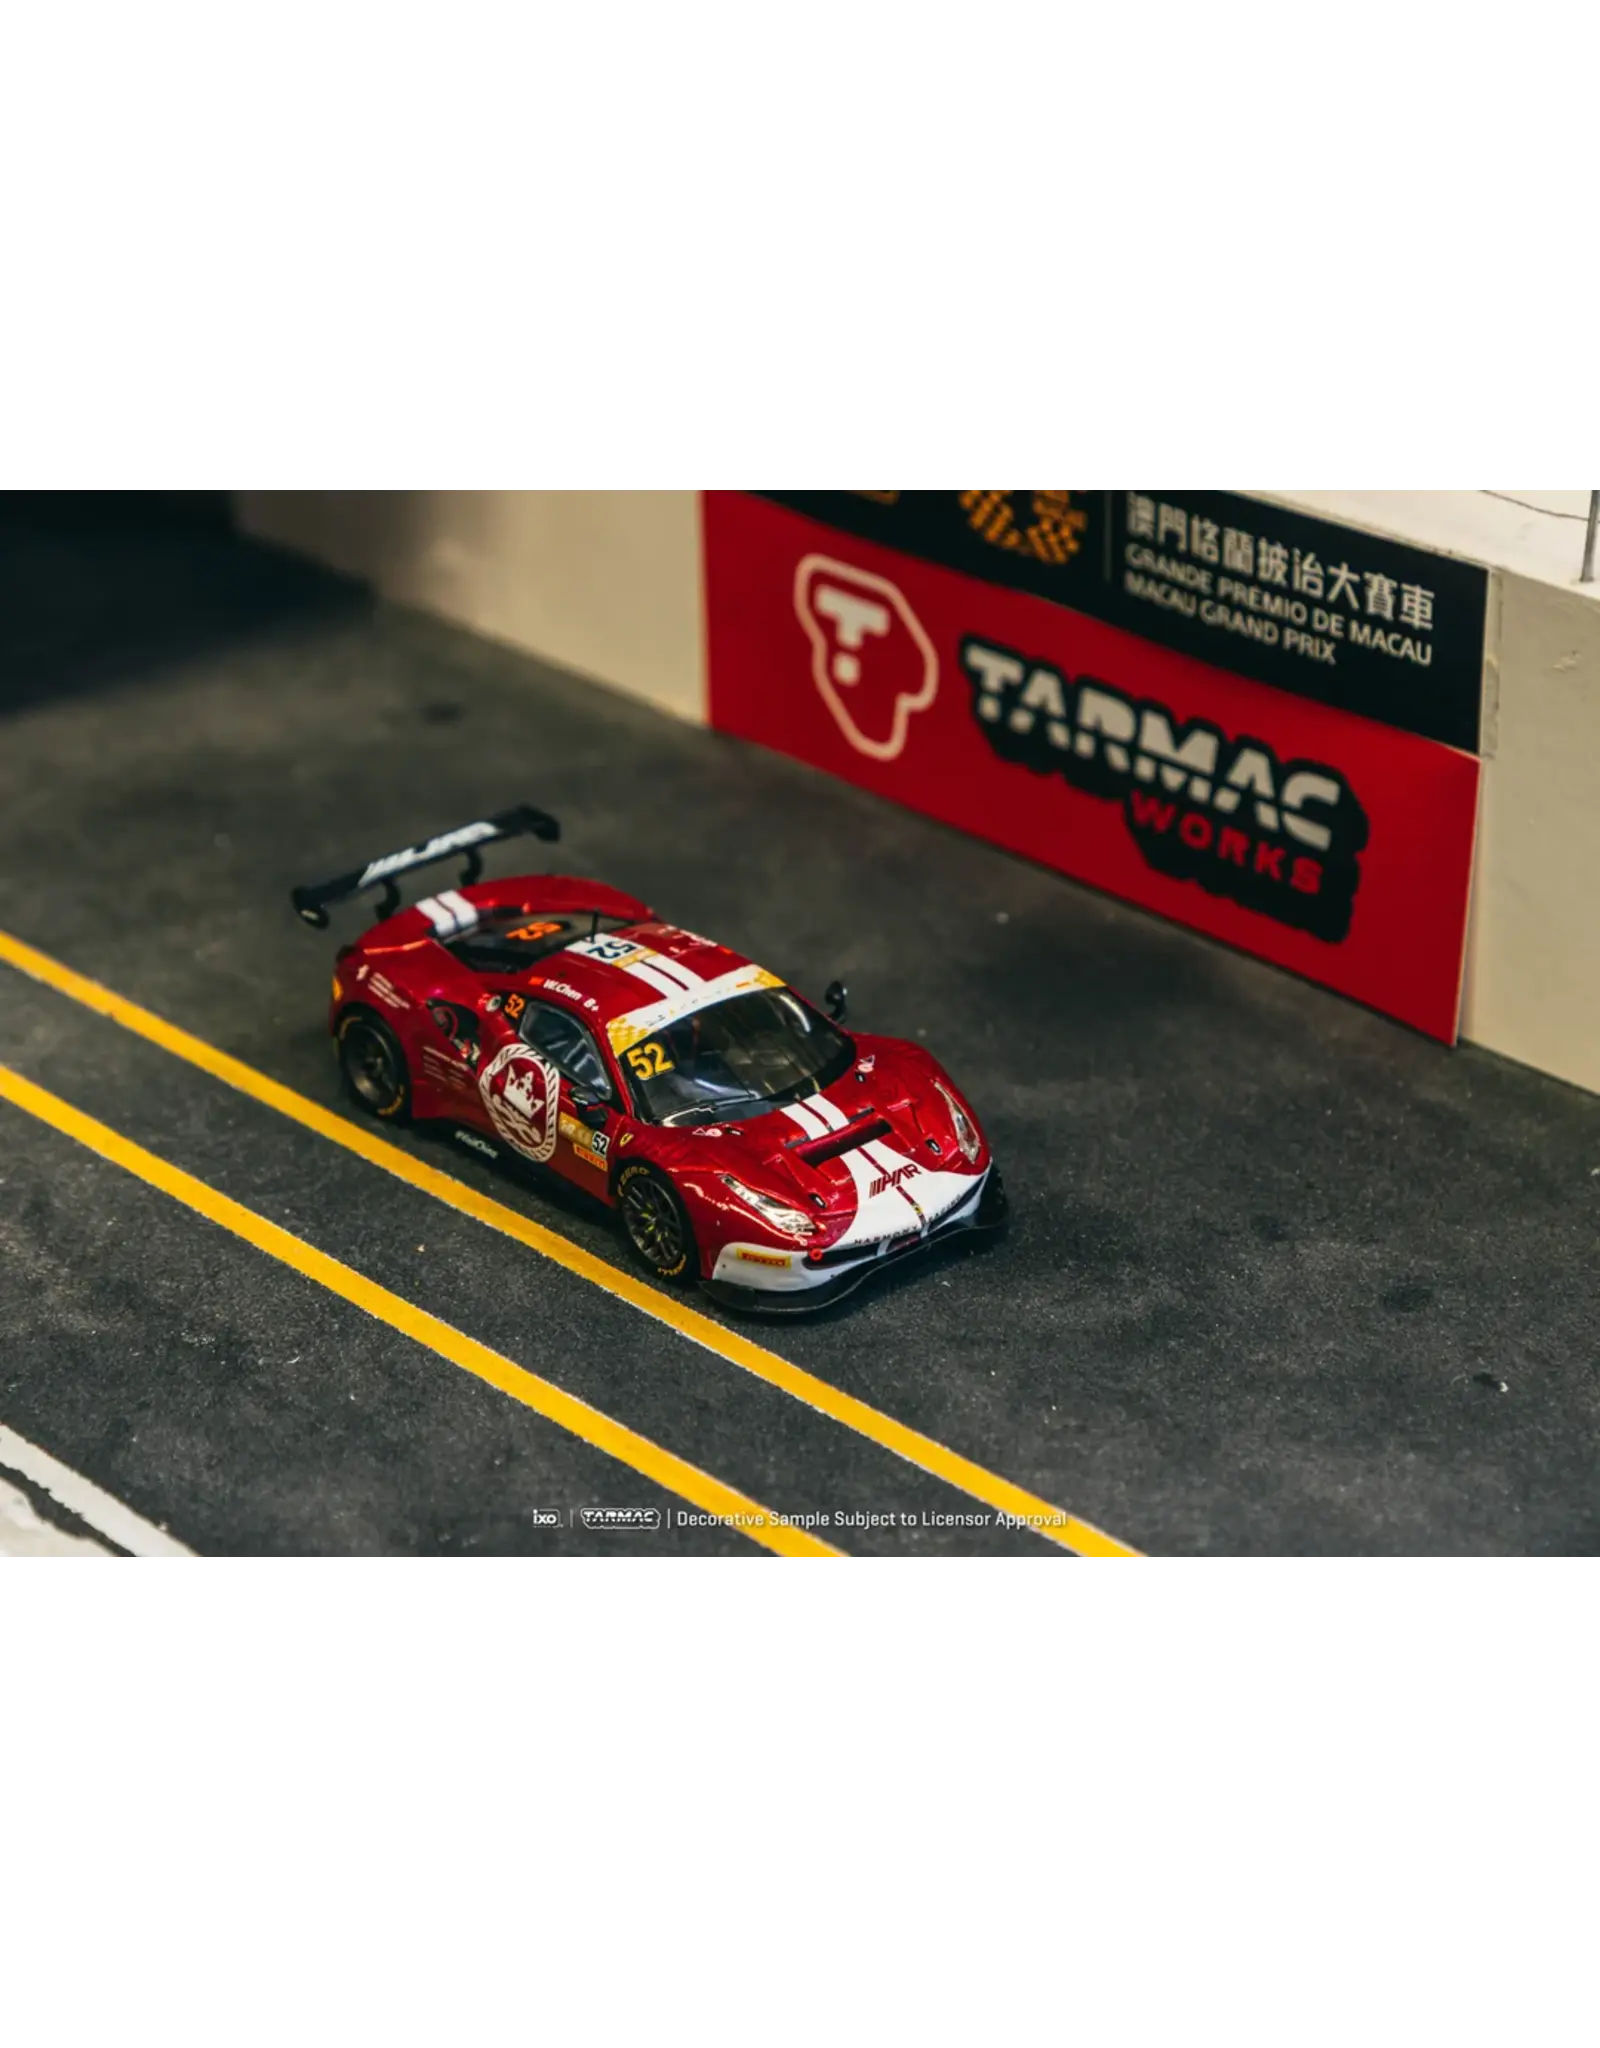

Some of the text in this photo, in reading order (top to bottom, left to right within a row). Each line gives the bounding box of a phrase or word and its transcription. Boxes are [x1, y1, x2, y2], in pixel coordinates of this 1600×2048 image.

[1125, 543, 1213, 593] GRANDE
[1312, 606, 1345, 638] DE
[1349, 620, 1432, 667] MACAU
[1125, 569, 1337, 666] MACAU GRAND PRIX
[964, 643, 1341, 852] TARMAC
[1131, 789, 1324, 896] WORKS
[504, 994, 526, 1020] 52
[627, 1042, 675, 1081] 52
[591, 1134, 608, 1156] 52
